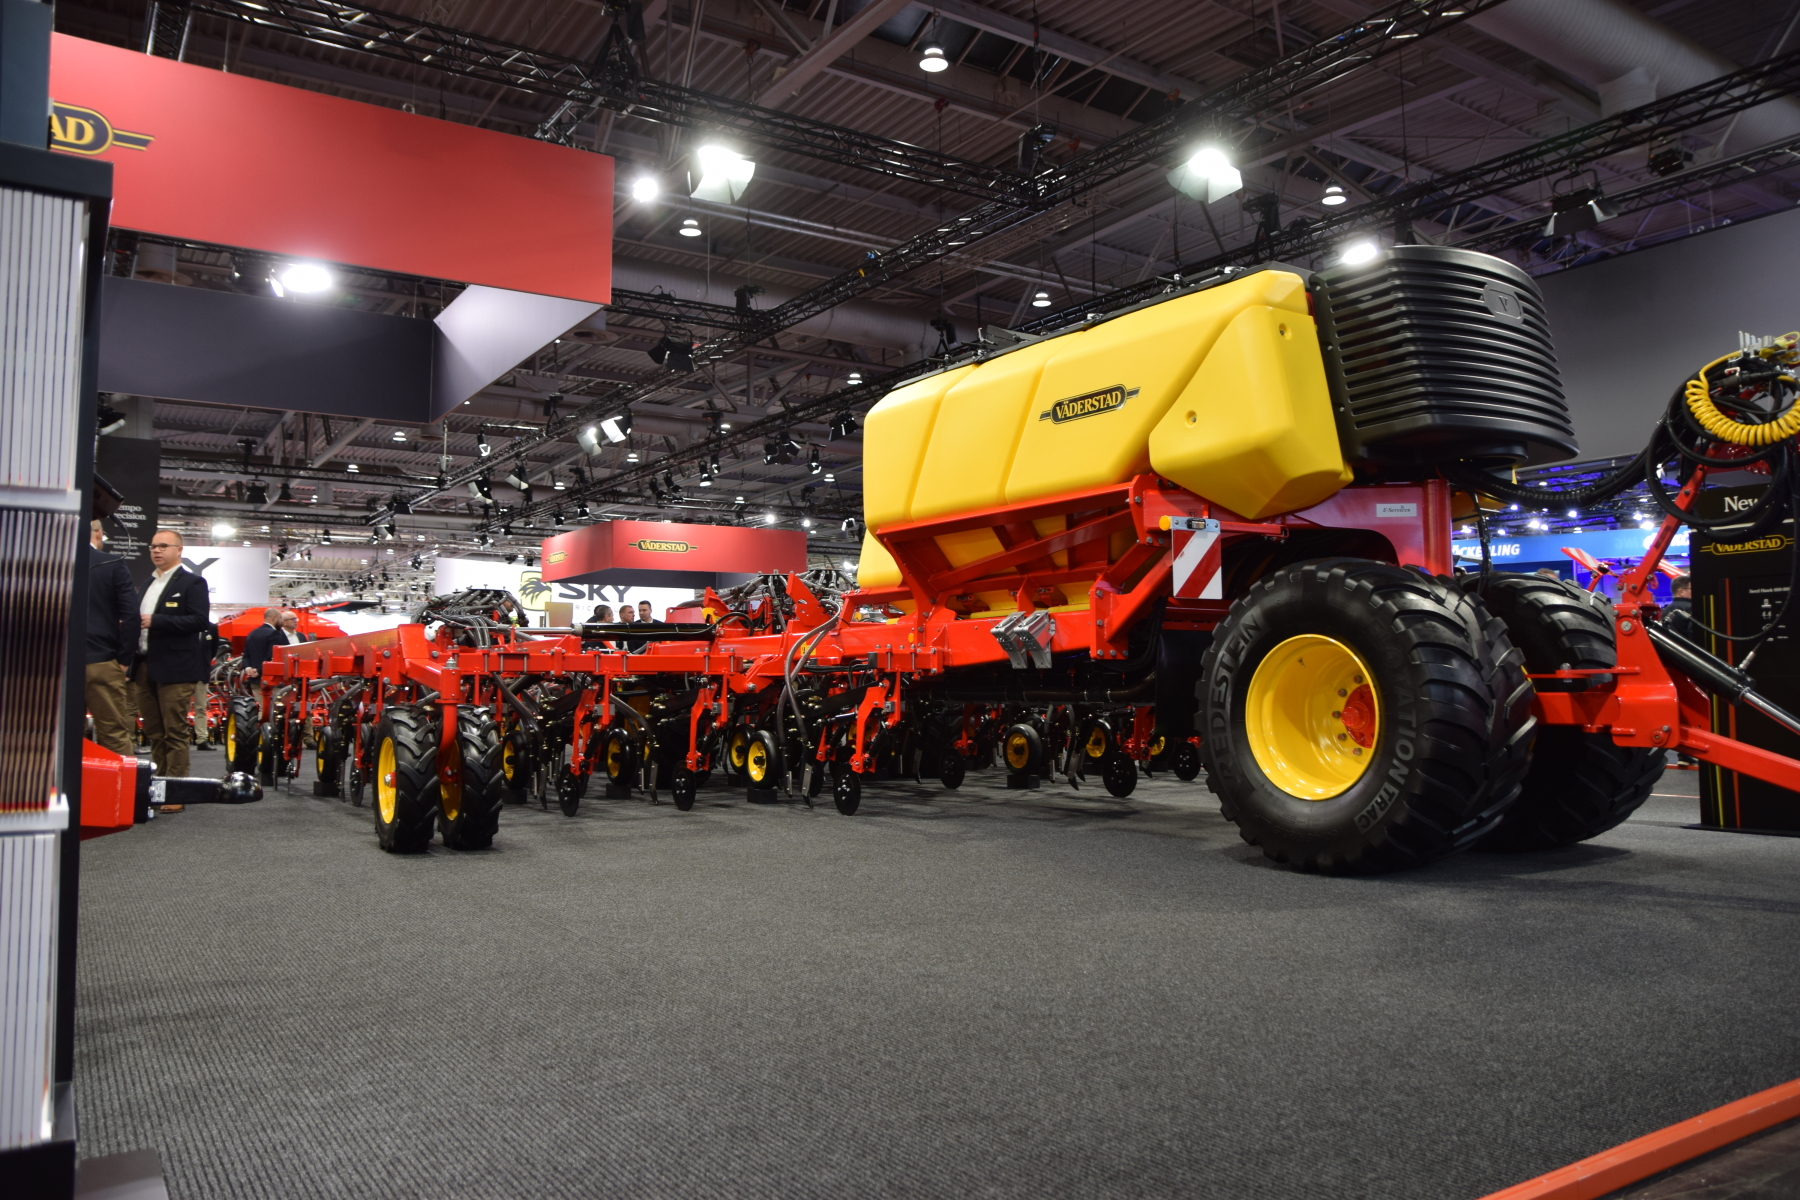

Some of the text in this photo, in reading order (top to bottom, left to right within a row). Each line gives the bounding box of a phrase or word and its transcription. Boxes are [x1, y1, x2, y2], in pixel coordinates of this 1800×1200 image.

[1056, 391, 1121, 419] VÄDERSTAD
[112, 512, 147, 521] recision
[118, 504, 142, 513] empo
[640, 540, 687, 552] VÄDERSTAD
[558, 582, 632, 603] SKY
[1357, 785, 1397, 830] TRAC
